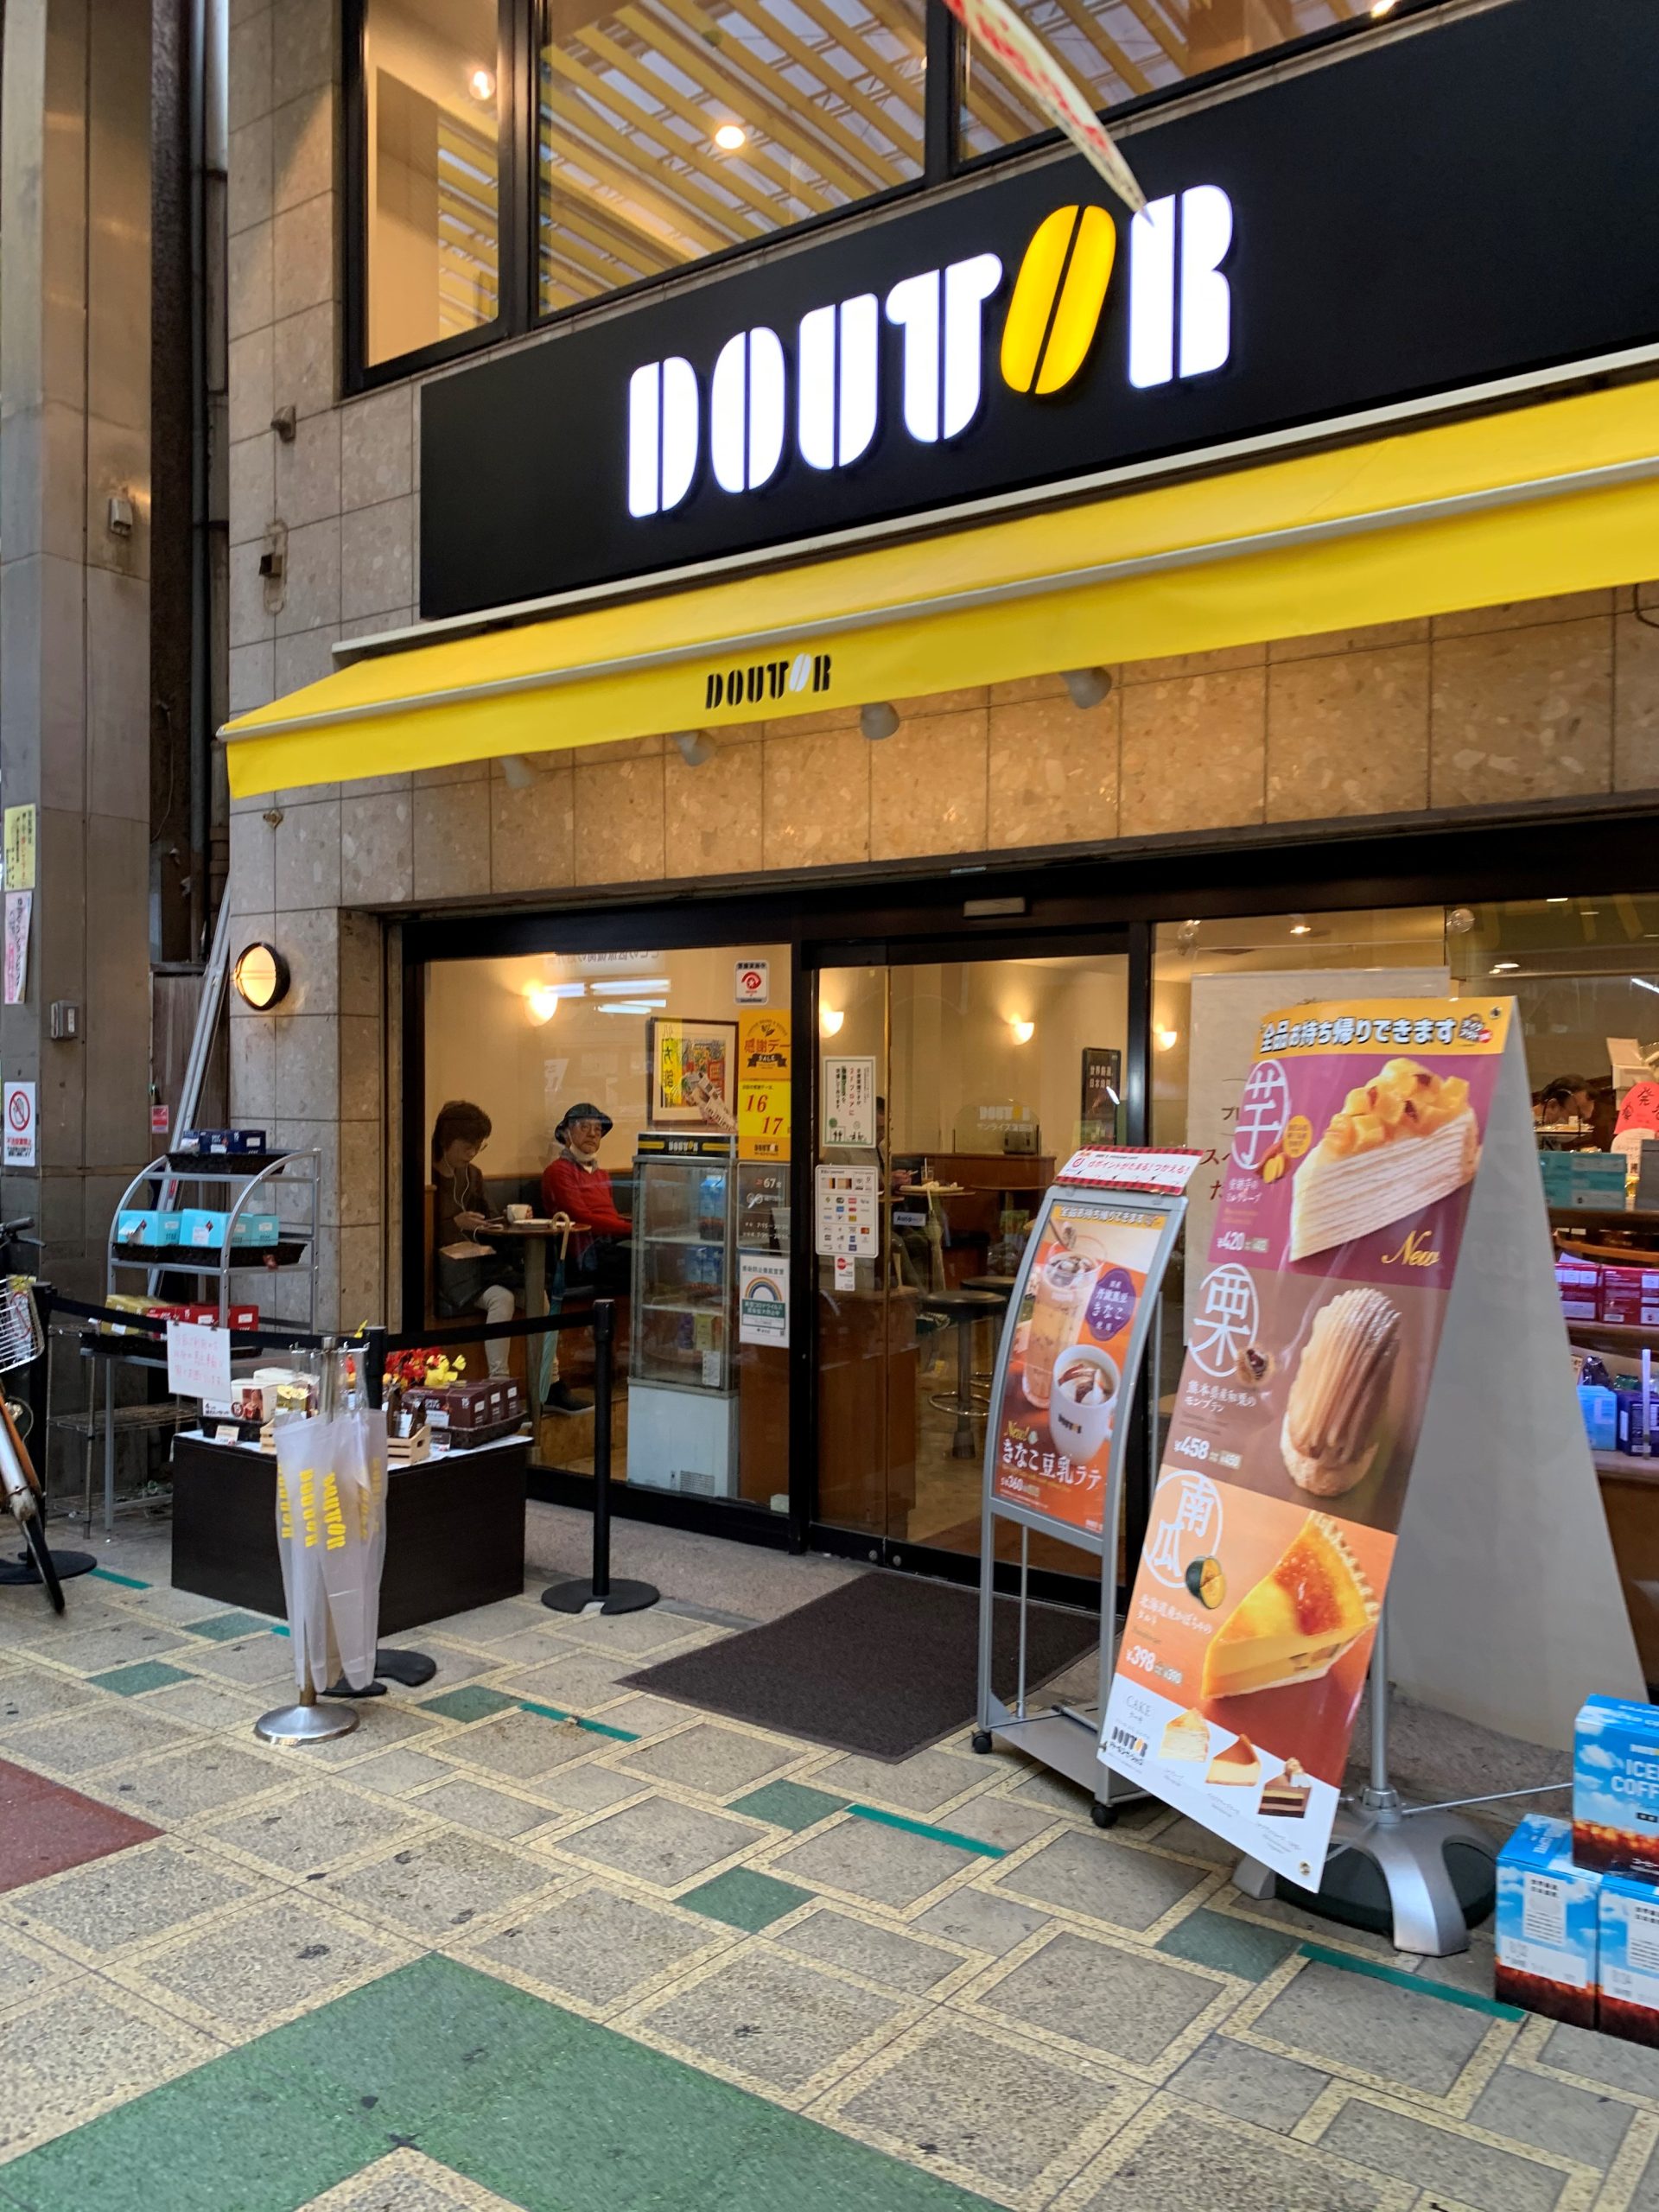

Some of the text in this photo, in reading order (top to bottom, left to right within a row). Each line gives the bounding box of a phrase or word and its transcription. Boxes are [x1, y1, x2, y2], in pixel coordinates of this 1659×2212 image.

[629, 184, 1233, 518] DOUTOR
[705, 652, 831, 709] DOUTOR
[1259, 1016, 1457, 1053] 全品お持ち帰りできます
[746, 1093, 768, 1113] 16
[762, 1116, 784, 1135] 17
[1381, 1230, 1441, 1268] New
[1091, 1301, 1124, 1321] きなこ
[1193, 1274, 1250, 1367] 栗
[1185, 1396, 1225, 1413] モンブラン
[1173, 1436, 1210, 1460] ¥458
[1002, 1438, 1103, 1491] きなこ豆乳ラテ
[322, 1472, 346, 1550] DOUTOR
[1126, 1645, 1156, 1672] ¥398
[1126, 1695, 1153, 1718] CAKE
[1111, 1726, 1148, 1758] DOUTOR
[1625, 1758, 1659, 1781] ICE
